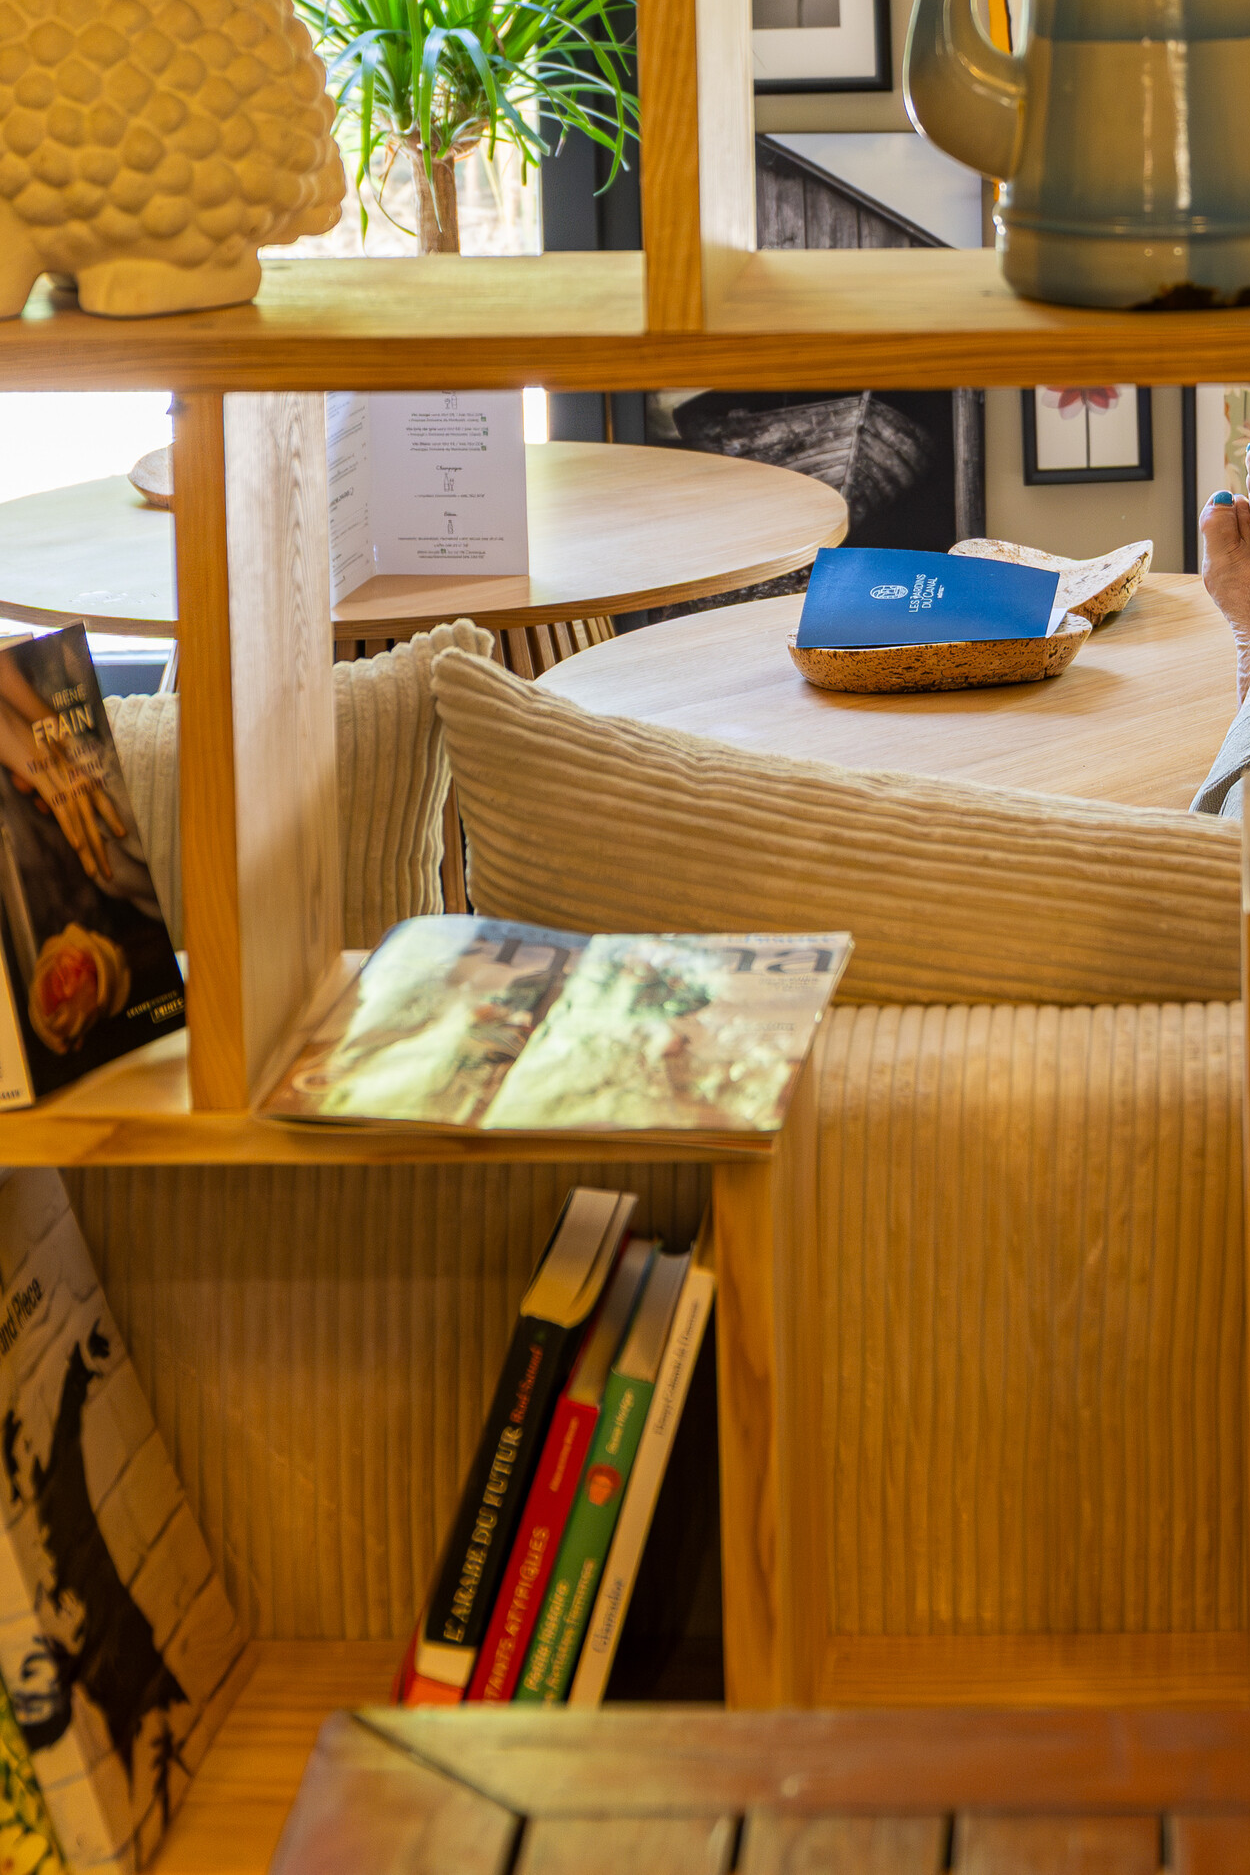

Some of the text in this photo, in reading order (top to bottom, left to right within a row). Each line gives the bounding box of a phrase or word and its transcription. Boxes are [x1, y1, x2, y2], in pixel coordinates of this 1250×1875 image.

[909, 573, 926, 613] LES JARDINS
[922, 577, 938, 609] DU CANAL
[31, 702, 95, 750] FRAIN
[440, 1422, 526, 1644] L'ARABE DU FUTUR
[498, 1523, 553, 1637] ATYPIQUES
